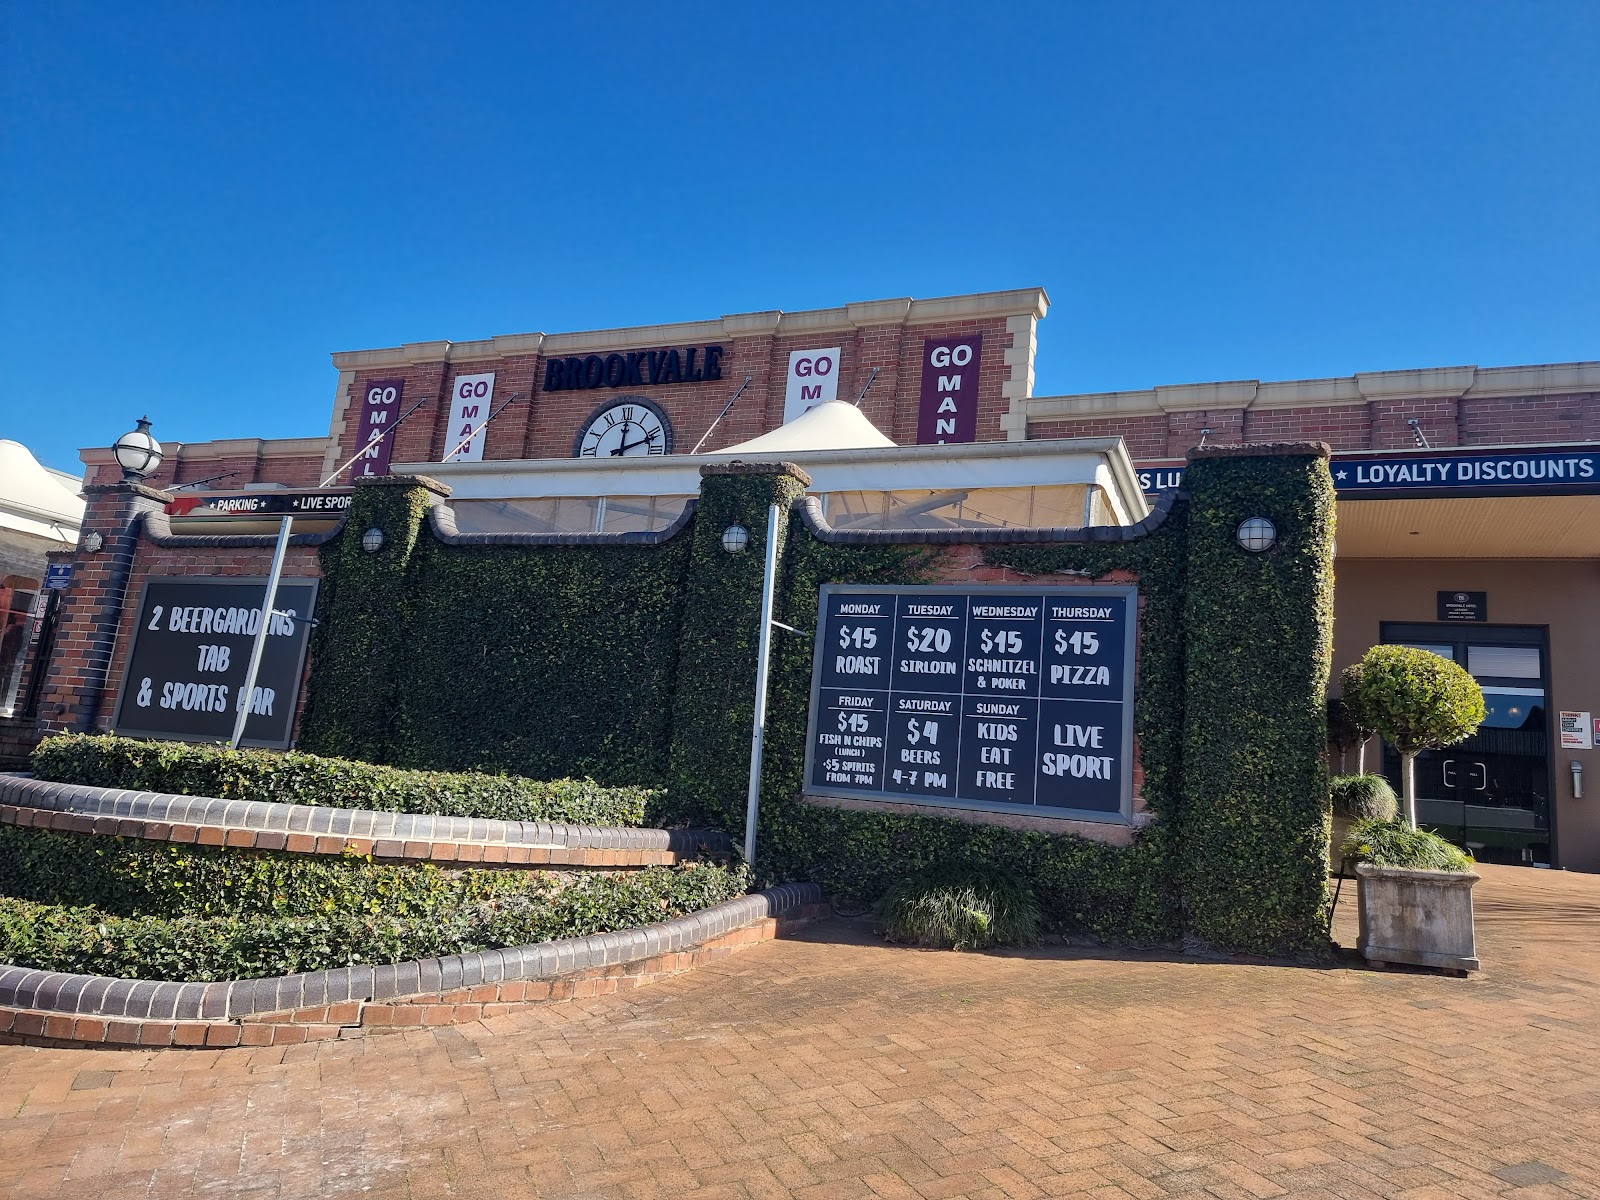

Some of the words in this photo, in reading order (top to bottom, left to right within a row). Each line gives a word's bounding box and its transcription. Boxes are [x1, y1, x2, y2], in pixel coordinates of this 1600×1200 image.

[930, 344, 973, 368] GO
[542, 345, 723, 392] BROOKVALE
[795, 356, 833, 377] GO
[368, 387, 397, 405] GO
[459, 381, 489, 399] GO
[1356, 463, 1452, 484] LOYALTY
[1457, 458, 1595, 481] DISCOUNTS
[216, 498, 259, 512] PARKING
[300, 496, 323, 510] LIVE
[840, 604, 881, 614] MONDAY
[908, 605, 953, 616] TUESDAY
[972, 606, 1038, 617] WEDNESDAY
[1052, 607, 1112, 618] THURSDAY
[147, 605, 164, 631] 2
[169, 606, 297, 637] BEERGARDNS
[839, 625, 877, 649] $15
[907, 626, 951, 653] $20
[980, 628, 1022, 654] $15
[1054, 629, 1099, 655] $15
[197, 644, 231, 672] TAB
[835, 655, 881, 675] ROAST
[900, 660, 956, 674] SIRLOIN
[968, 658, 1037, 674] SCHNITZEL
[977, 676, 986, 688] &
[991, 677, 1026, 690] POKER
[1050, 664, 1109, 686] PIZZA
[136, 676, 153, 708] &
[160, 681, 228, 713] SPORTS
[838, 696, 874, 707] FRIDAY
[899, 699, 952, 711] SATURDAY
[976, 703, 1020, 715] SUNDAY
[837, 711, 868, 732] $15
[819, 733, 841, 745] FISH
[843, 735, 851, 746] N
[853, 736, 882, 748] CHIPS
[977, 722, 1018, 741] KIDS
[1053, 724, 1104, 749] LIVE
[900, 749, 940, 764] BEERS
[980, 747, 1012, 765] EAT
[841, 762, 875, 773] SPIRITS
[1042, 752, 1114, 780] SPORT
[825, 772, 851, 783] FROM
[854, 774, 873, 785] 7PM
[892, 769, 918, 785] 4-7
[924, 771, 947, 788] PM
[976, 770, 1016, 790] FREE
